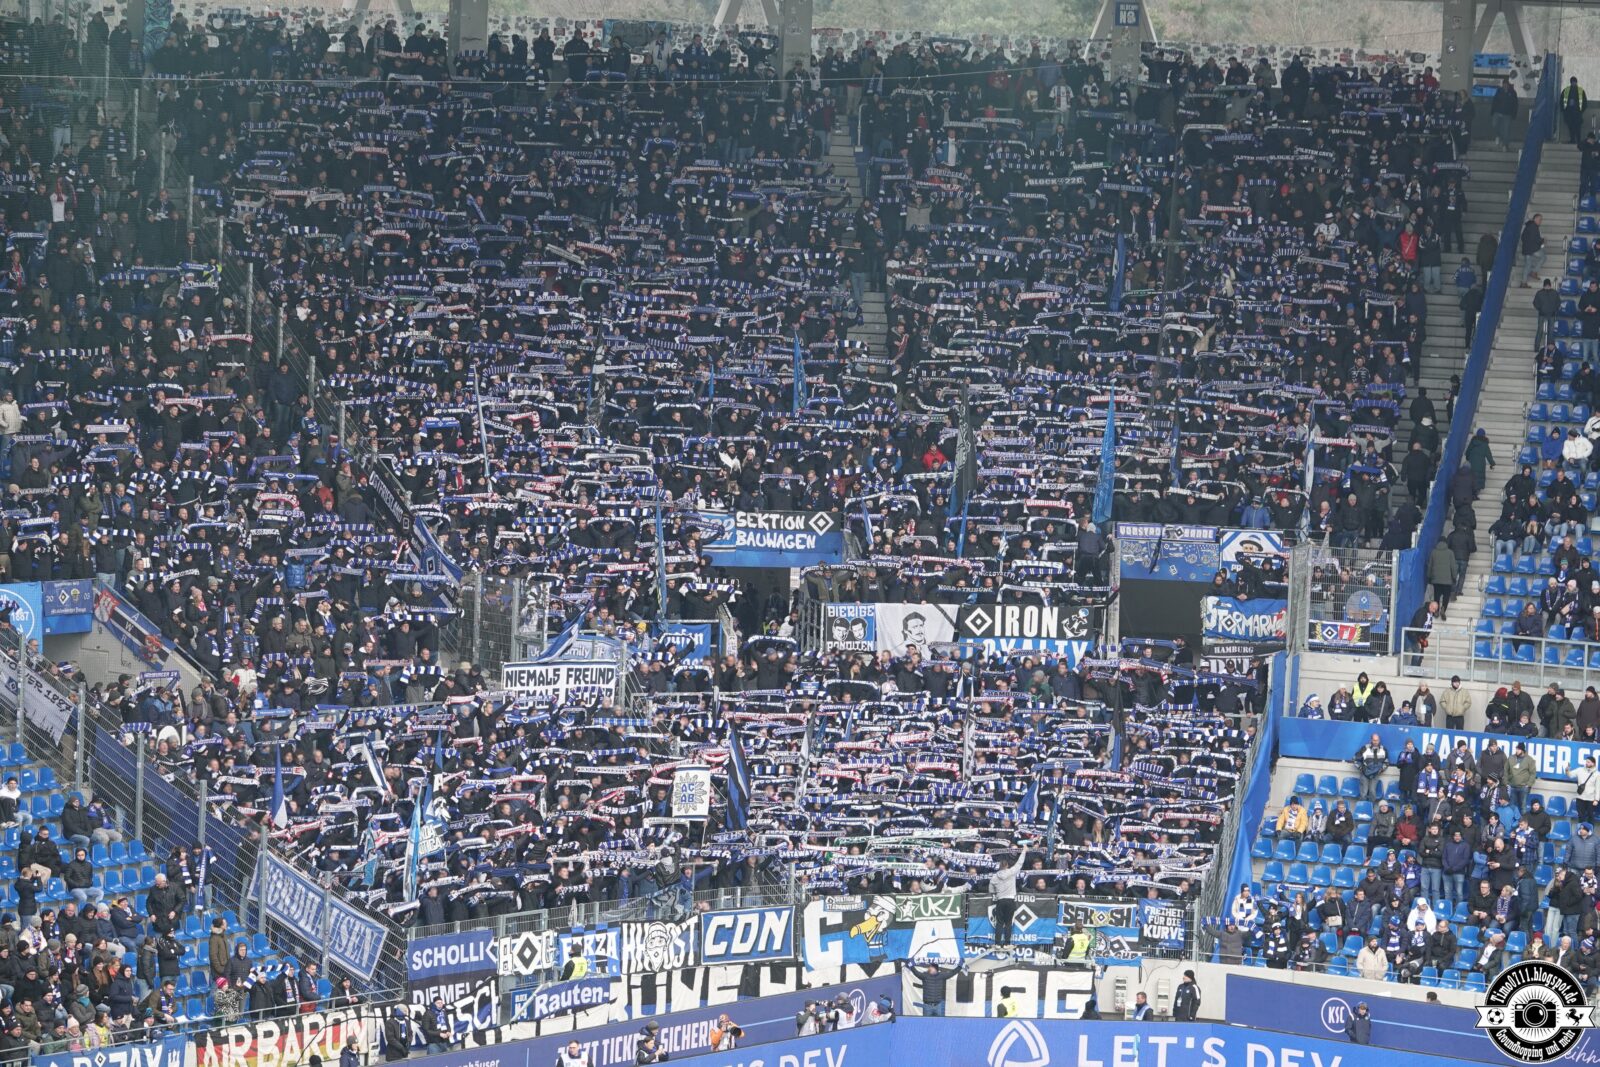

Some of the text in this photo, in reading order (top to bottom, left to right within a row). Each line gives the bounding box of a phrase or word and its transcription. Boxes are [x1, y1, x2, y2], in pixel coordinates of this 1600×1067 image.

[736, 512, 805, 531] SEKTION
[736, 530, 816, 549] BAUWAGEN
[994, 605, 1059, 638] IRON
[1214, 646, 1254, 654] HAMBURG
[505, 667, 614, 688] NIEMALS FREUND
[1144, 907, 1184, 918] FREIHEIT
[1148, 916, 1182, 928] FÜR DIE
[705, 910, 790, 956] CDN
[1142, 925, 1184, 941] KURVE
[412, 941, 484, 971] SCHOLLI
[534, 984, 609, 1018] Rauten-
[1328, 1005, 1346, 1024] KSC
[1078, 1034, 1227, 1067] LET'S
